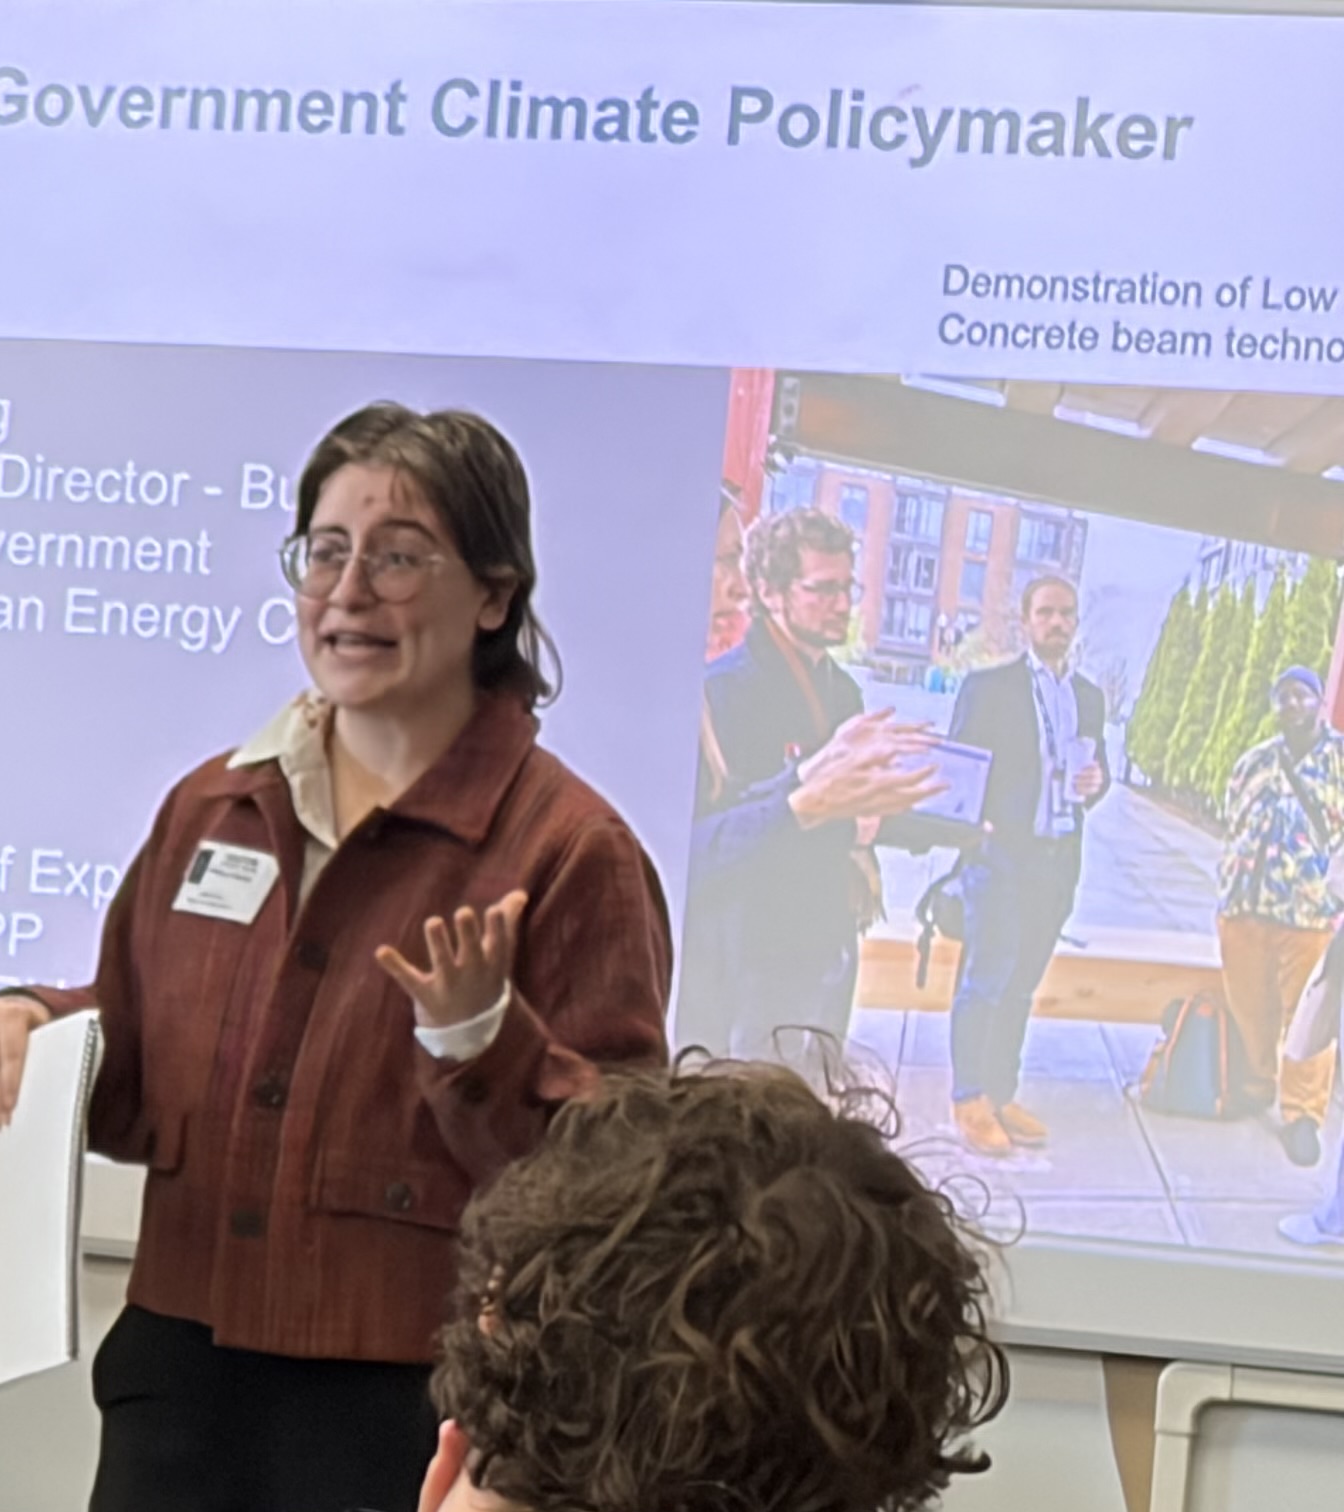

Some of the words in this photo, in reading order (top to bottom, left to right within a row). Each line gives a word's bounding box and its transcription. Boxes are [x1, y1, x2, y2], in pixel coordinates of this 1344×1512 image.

[429, 78, 700, 145] Climate
[726, 84, 1195, 168] Policymaker
[942, 263, 1203, 308] Demonstration
[1215, 274, 1253, 309] of
[1262, 277, 1339, 313] Low
[938, 312, 1099, 351] Concrete
[1111, 320, 1212, 358] beam
[1225, 325, 1344, 363] techno
[203, 486, 224, 496] -
[240, 462, 297, 513] Bu
[64, 586, 243, 655] Energy
[257, 597, 298, 646] C
[29, 847, 120, 911] Exp
